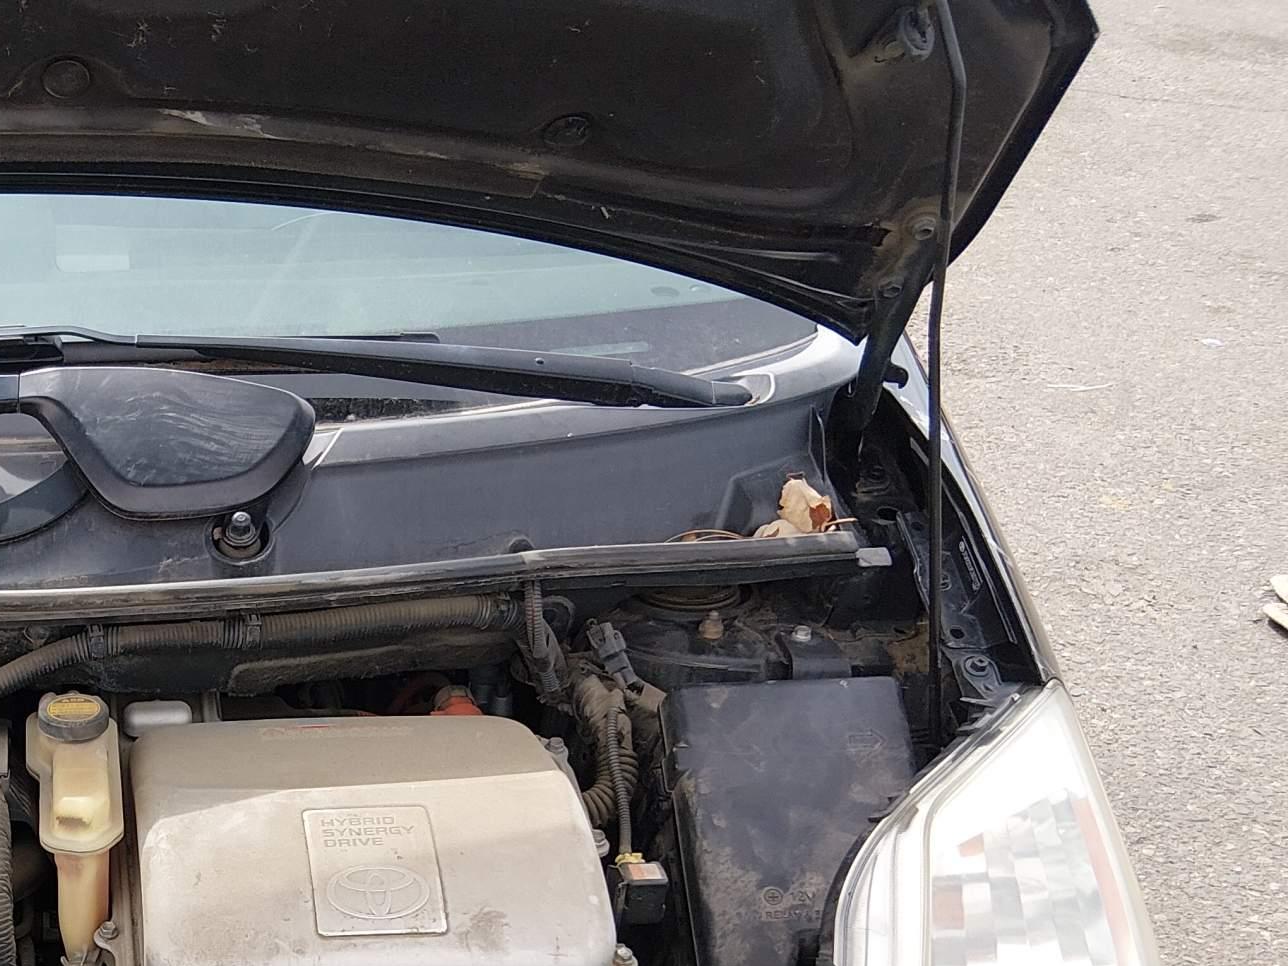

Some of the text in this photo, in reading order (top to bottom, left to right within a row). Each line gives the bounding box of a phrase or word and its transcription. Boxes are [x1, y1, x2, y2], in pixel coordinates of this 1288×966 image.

[320, 816, 395, 826] HYBRID
[322, 825, 415, 838] SYNERGY
[324, 837, 384, 848] DRIVE
